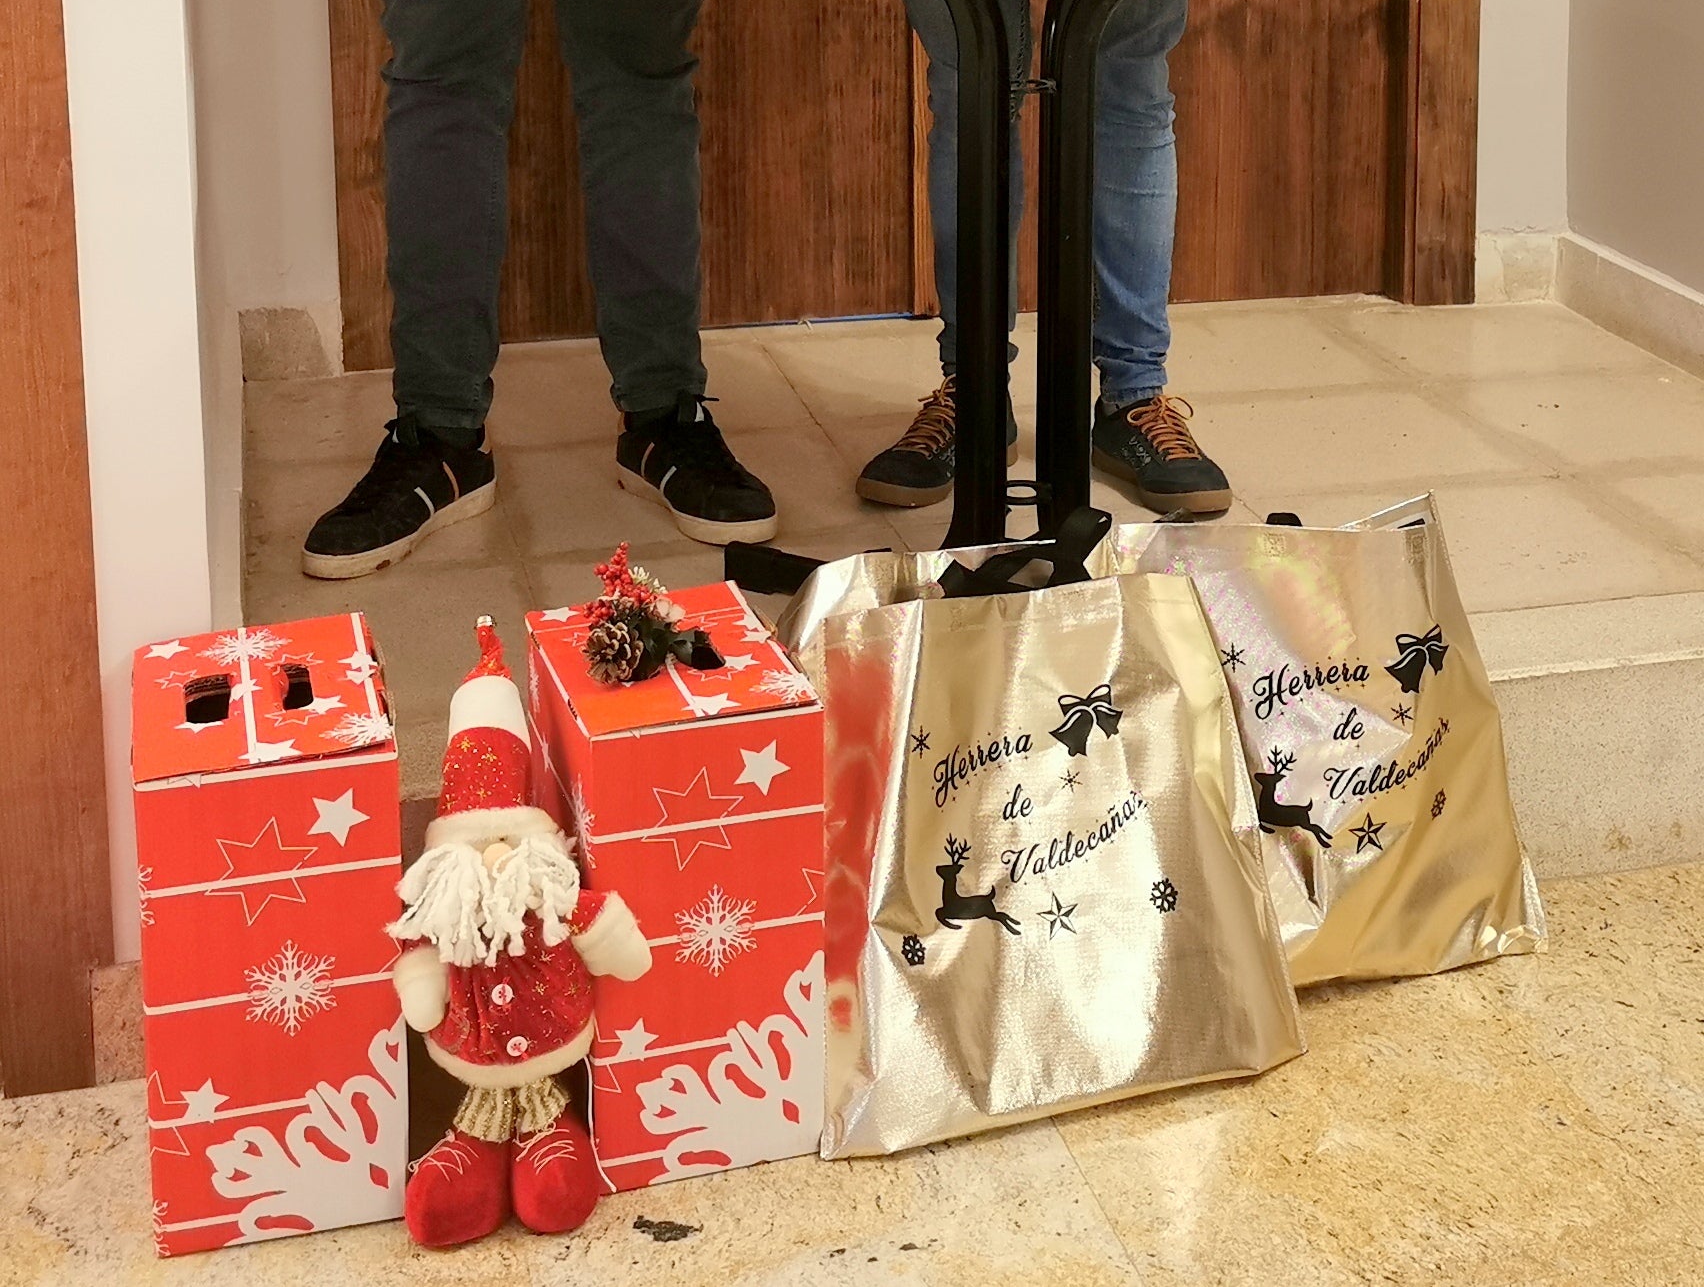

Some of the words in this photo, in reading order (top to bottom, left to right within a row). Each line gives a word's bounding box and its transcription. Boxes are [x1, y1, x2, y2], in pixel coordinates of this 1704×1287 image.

[1252, 663, 1369, 720] Herrera
[1333, 707, 1365, 740] de
[934, 732, 1033, 808] Herrera
[1323, 716, 1450, 800] Valdecañas
[1002, 783, 1033, 822] de
